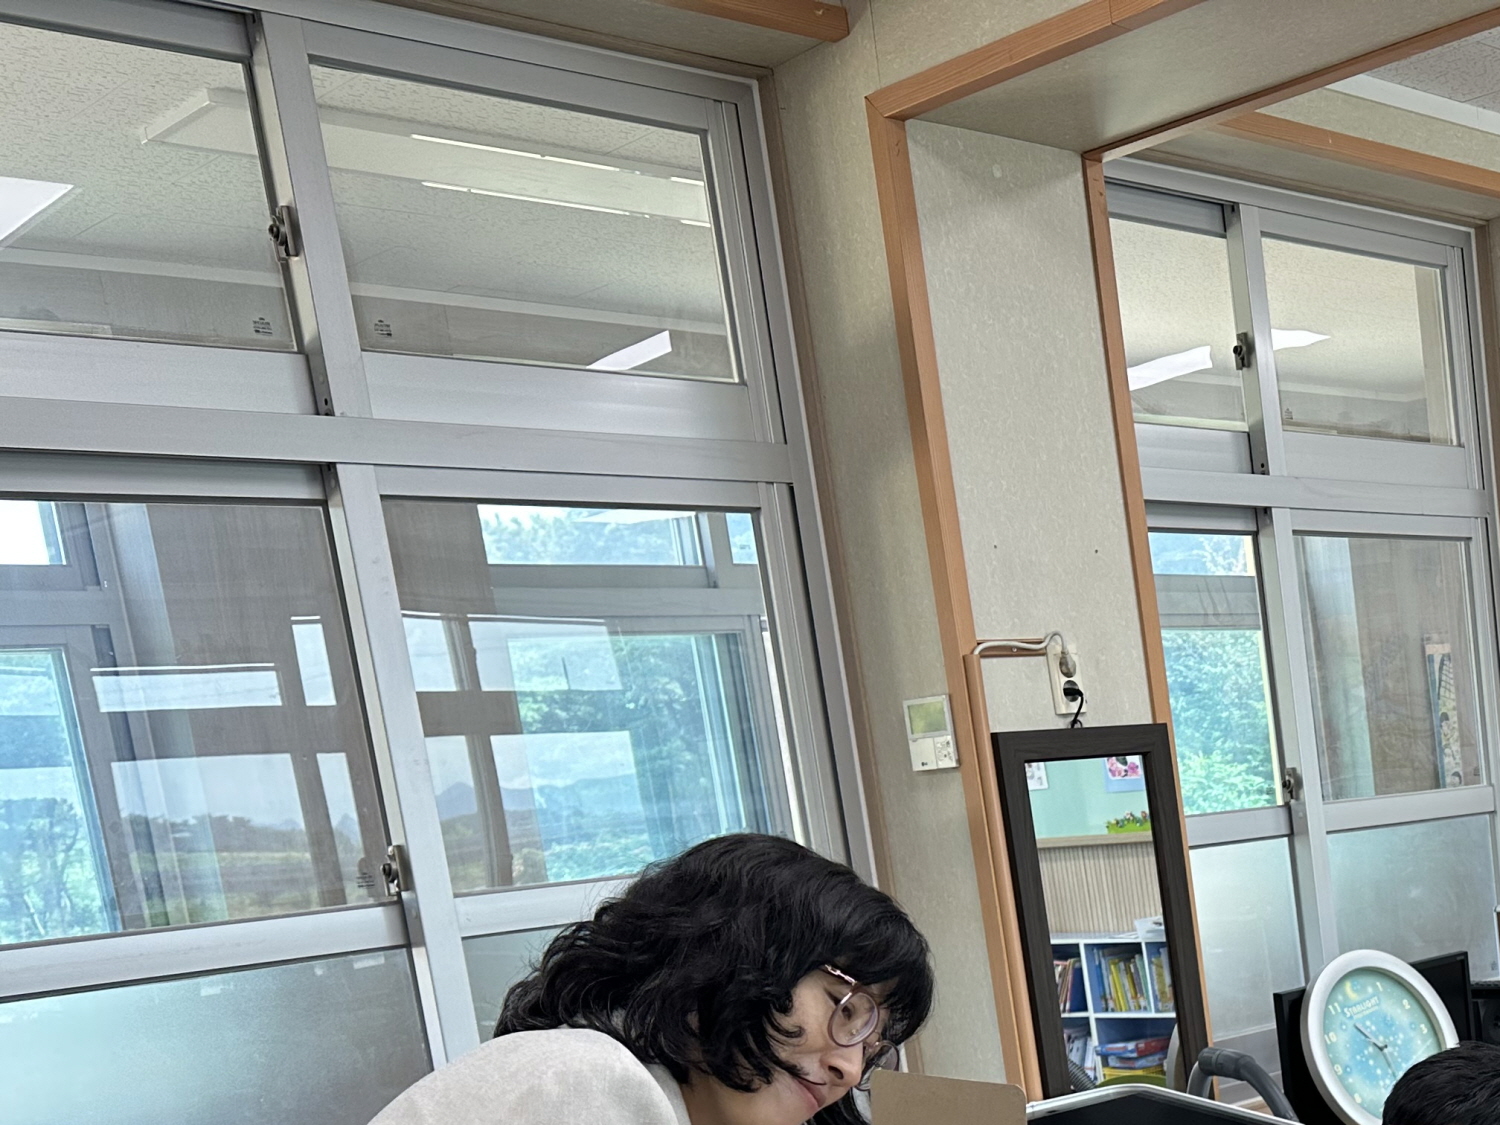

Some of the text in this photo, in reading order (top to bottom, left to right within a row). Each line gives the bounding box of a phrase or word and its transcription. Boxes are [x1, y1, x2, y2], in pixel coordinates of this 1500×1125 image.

[1328, 1002, 1341, 1015] 11
[1402, 999, 1411, 1010] 2
[1420, 1023, 1428, 1034] 3
[1324, 1032, 1337, 1045] 10
